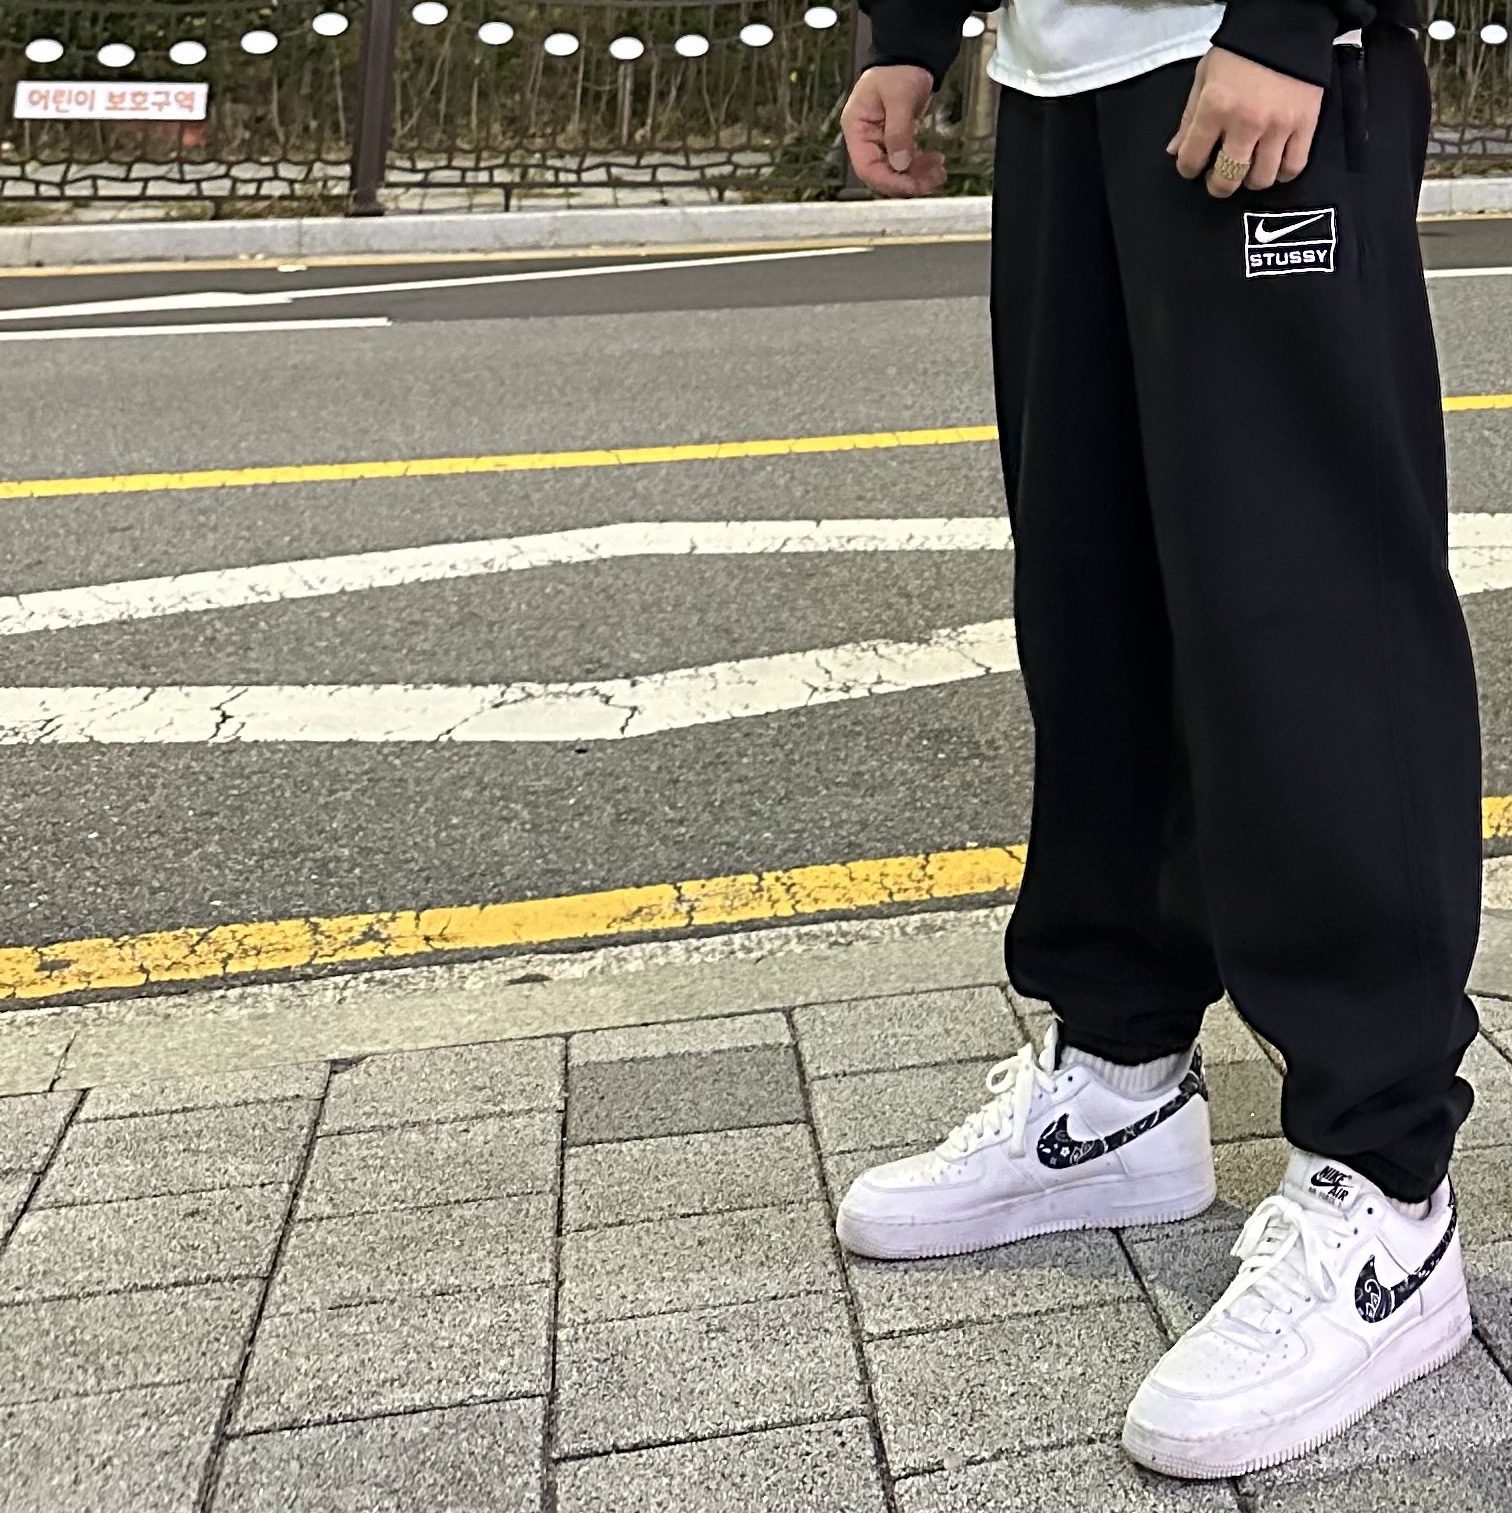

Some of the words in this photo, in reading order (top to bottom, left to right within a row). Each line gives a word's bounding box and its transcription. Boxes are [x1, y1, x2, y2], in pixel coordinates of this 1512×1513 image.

[27, 88, 96, 114] 어린이
[104, 90, 197, 113] 보호구역
[1249, 249, 1328, 268] STUSSY
[1319, 1165, 1348, 1183] NIKE
[1327, 1186, 1349, 1202] AIR
